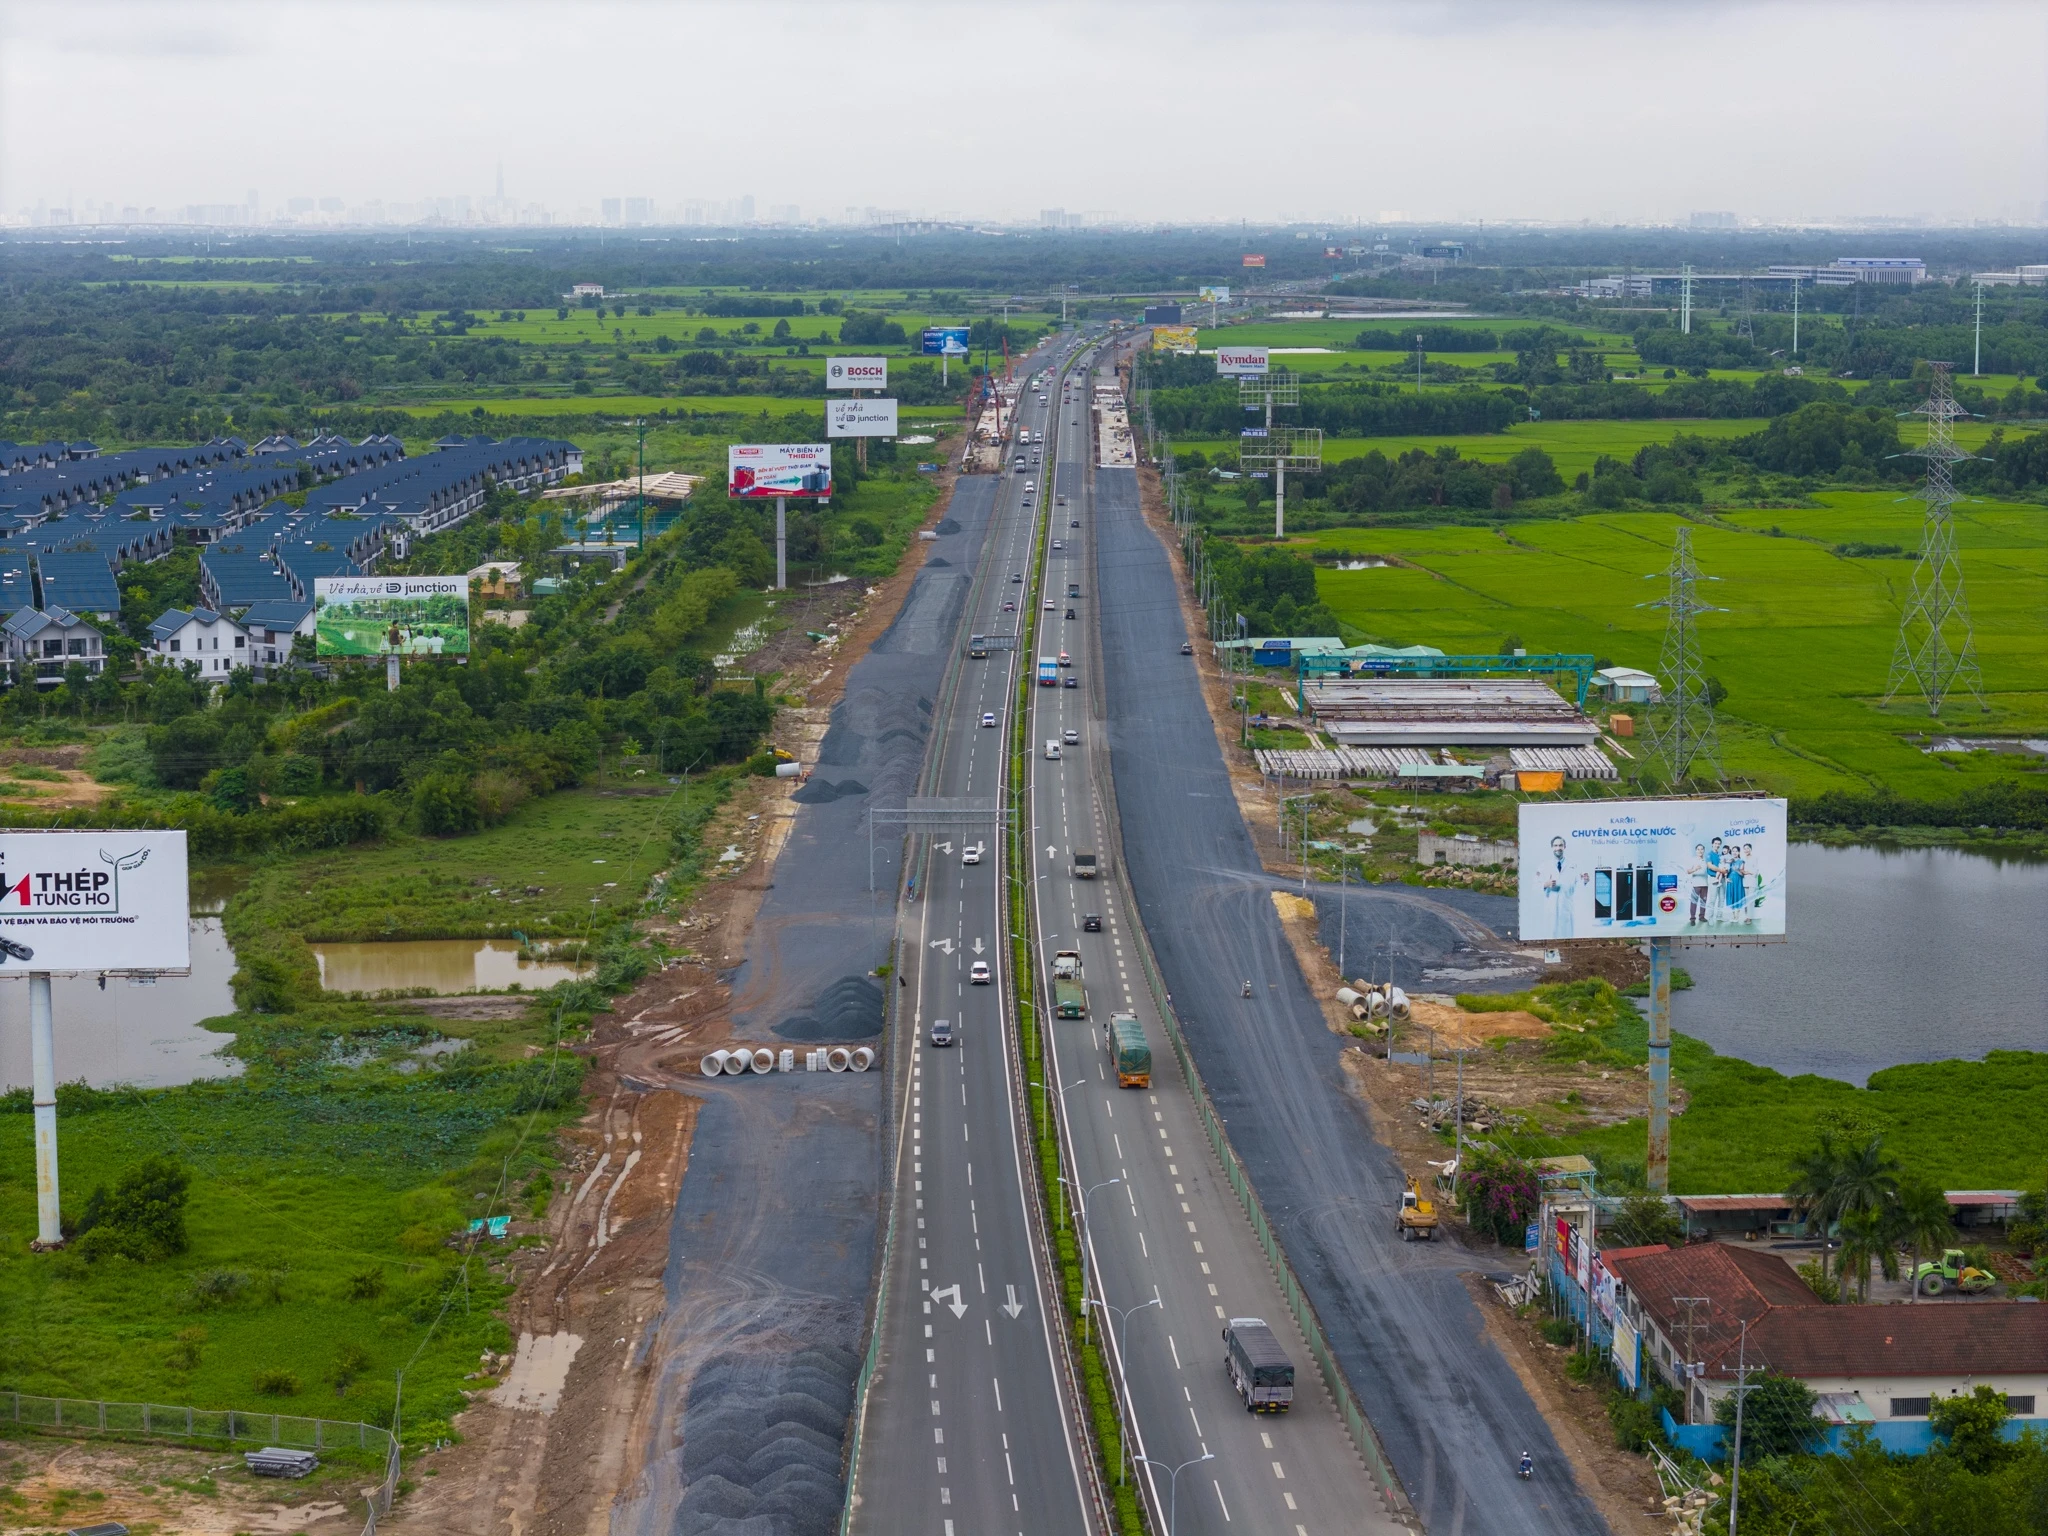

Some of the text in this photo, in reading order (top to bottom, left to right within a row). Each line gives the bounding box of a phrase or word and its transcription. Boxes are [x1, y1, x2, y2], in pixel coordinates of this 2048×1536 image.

[1221, 354, 1265, 366] Kymdan
[848, 367, 883, 376] BOSCH
[848, 402, 863, 412] nhà
[857, 414, 889, 423] junction
[329, 583, 345, 594] Về
[405, 582, 457, 596] junction
[1572, 826, 1677, 838] CHUYÊN GIA LỌC NƯỚC
[1724, 828, 1741, 837] SỨC
[35, 868, 110, 892] THÉP
[33, 892, 110, 906] TUNG HO
[4, 917, 16, 926] VỆ
[17, 918, 35, 926] BẠN
[37, 916, 48, 925] VÀ
[69, 916, 81, 926] VỆ
[82, 916, 98, 924] MÔI
